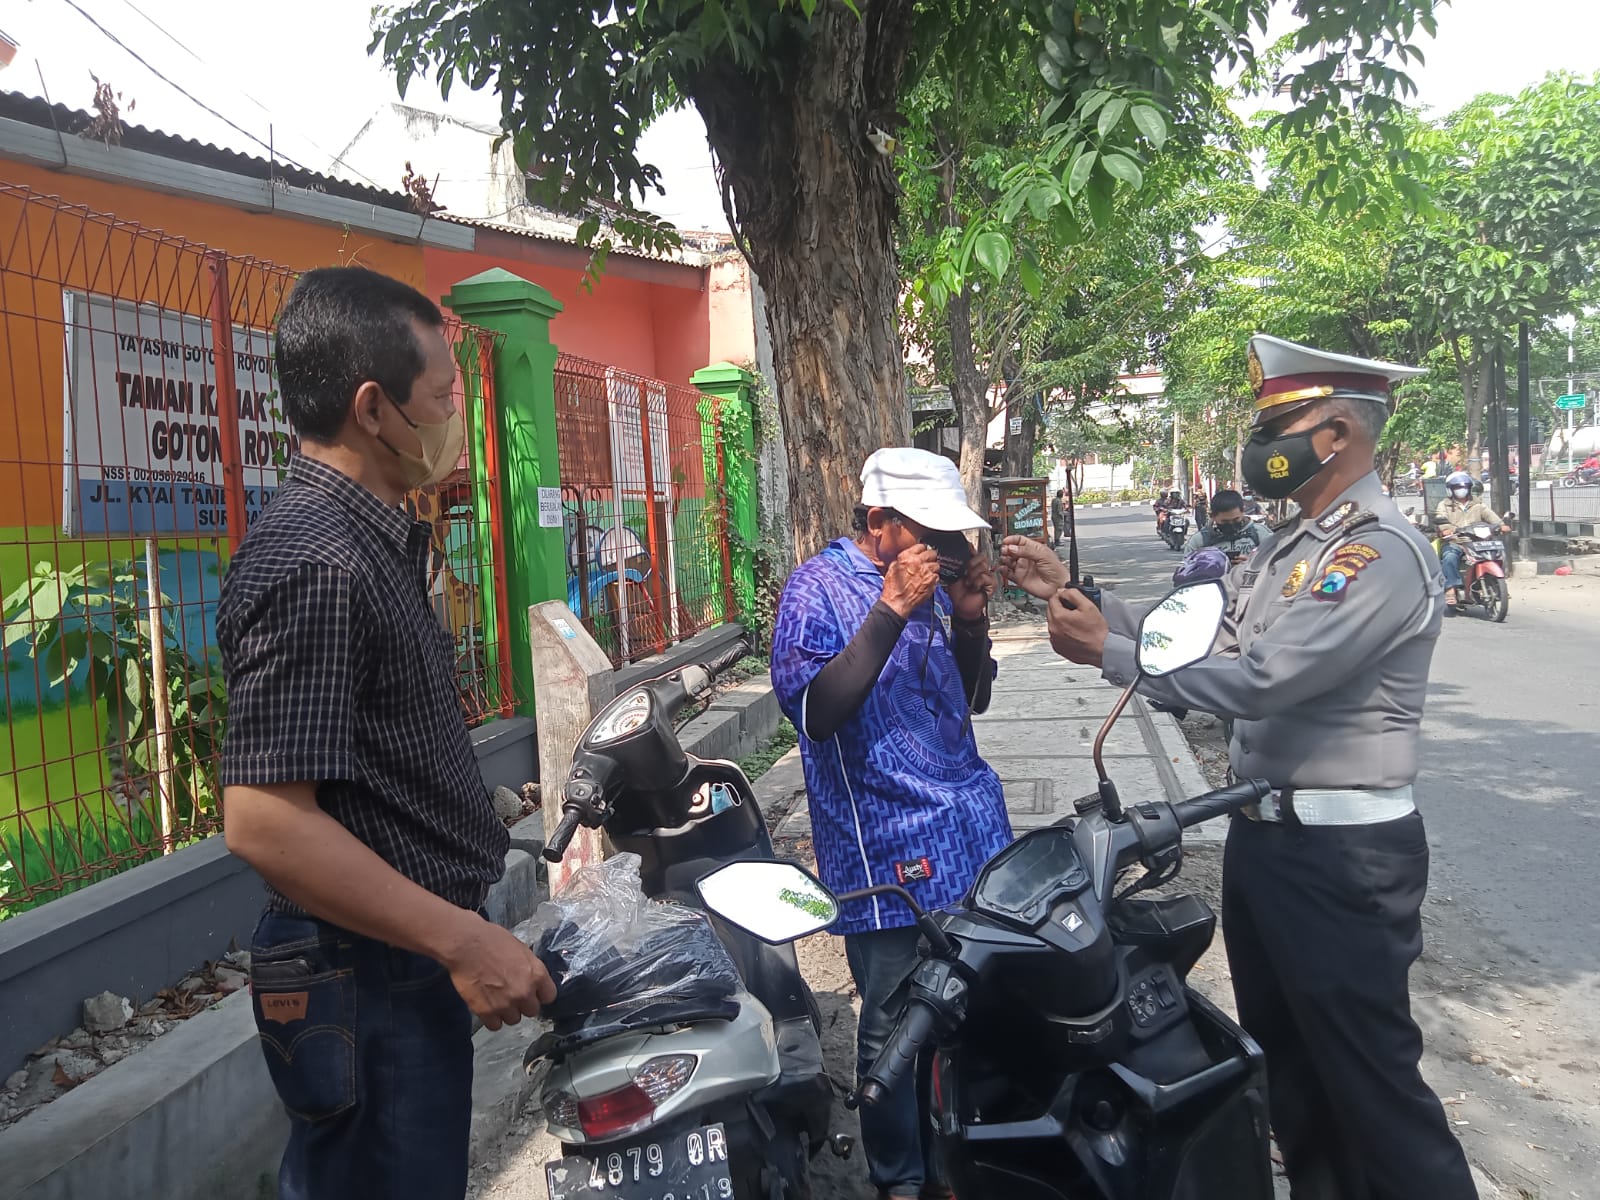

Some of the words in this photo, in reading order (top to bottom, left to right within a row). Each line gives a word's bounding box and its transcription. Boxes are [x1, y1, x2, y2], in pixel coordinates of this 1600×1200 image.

[118, 334, 179, 359] YAYASAN
[184, 344, 215, 366] GOTO
[116, 372, 193, 414] TAMAN
[200, 383, 267, 422] KAK
[152, 421, 223, 463] GOTON
[245, 429, 300, 467] ROYO
[1270, 471, 1289, 479] POLRI
[90, 485, 121, 503] JL.
[129, 486, 173, 504] KYAI
[181, 488, 255, 506] TAMK
[928, 764, 944, 779] DEL
[549, 1168, 565, 1200] L
[589, 1143, 664, 1190] 4879
